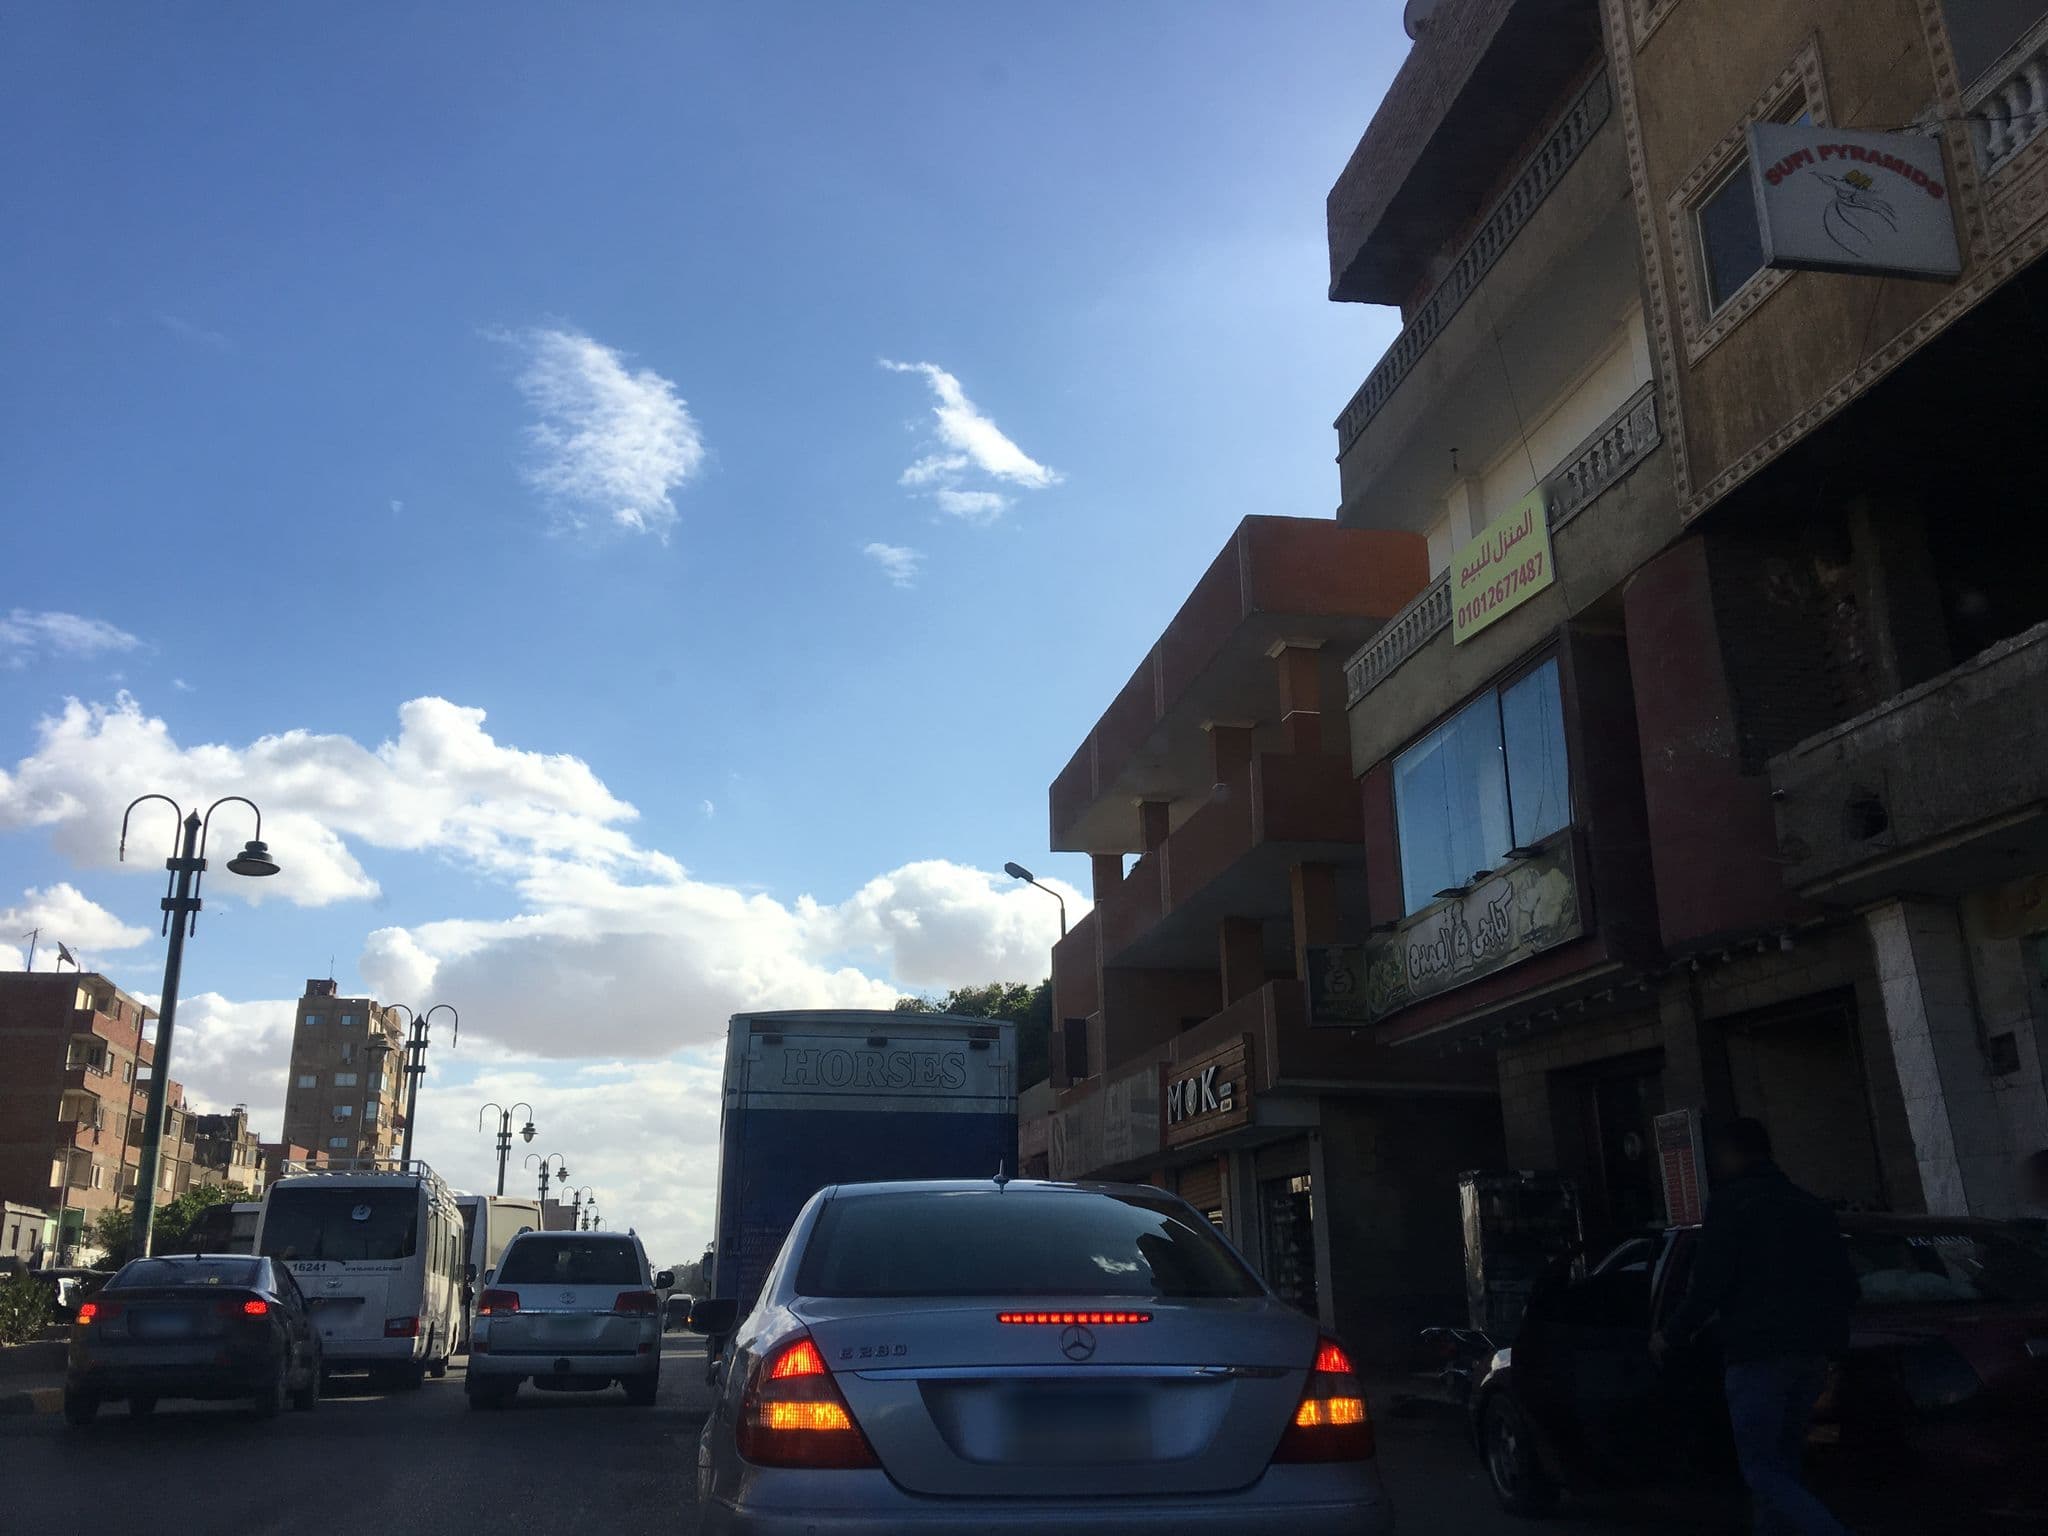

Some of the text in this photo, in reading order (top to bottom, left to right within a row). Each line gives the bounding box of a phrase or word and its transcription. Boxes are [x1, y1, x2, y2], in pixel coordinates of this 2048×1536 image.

[1817, 144, 1945, 199] PYRAMIDS
[1461, 508, 1533, 589] المنزل للبيع
[1458, 552, 1543, 629] 01012677487
[782, 1048, 966, 1089] HORSES
[293, 1263, 327, 1272] 16241
